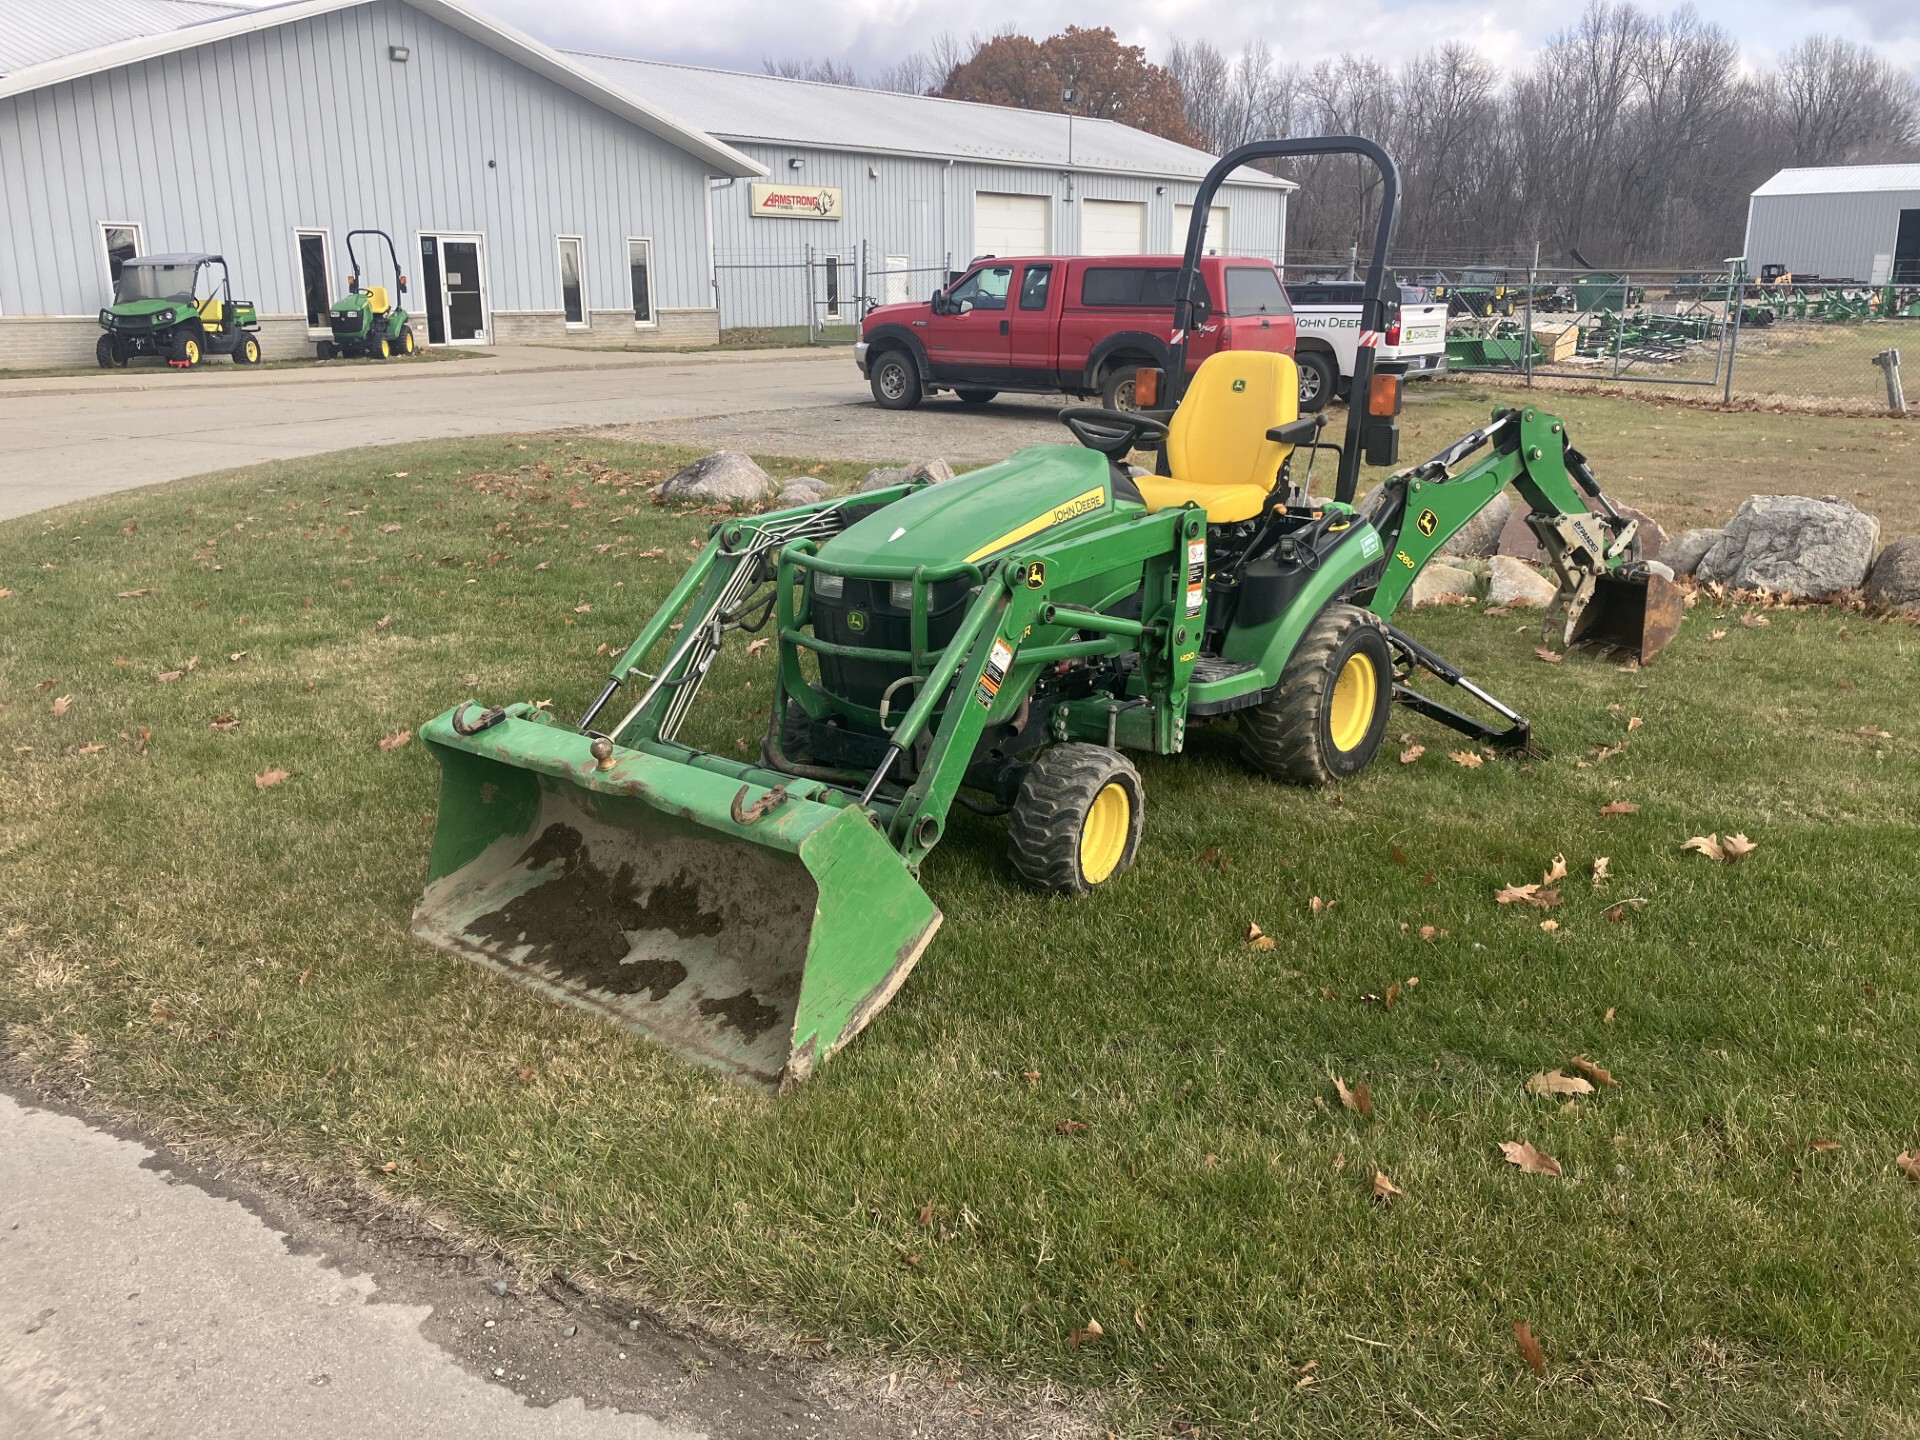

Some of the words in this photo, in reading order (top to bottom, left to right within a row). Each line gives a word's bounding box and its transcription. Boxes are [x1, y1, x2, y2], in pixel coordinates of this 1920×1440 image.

[762, 192, 818, 207] ARMSTRONG
[1296, 317, 1327, 328] JOHN
[1052, 505, 1075, 524] JOHN
[1074, 495, 1101, 512] DEERE
[1396, 550, 1415, 570] 260
